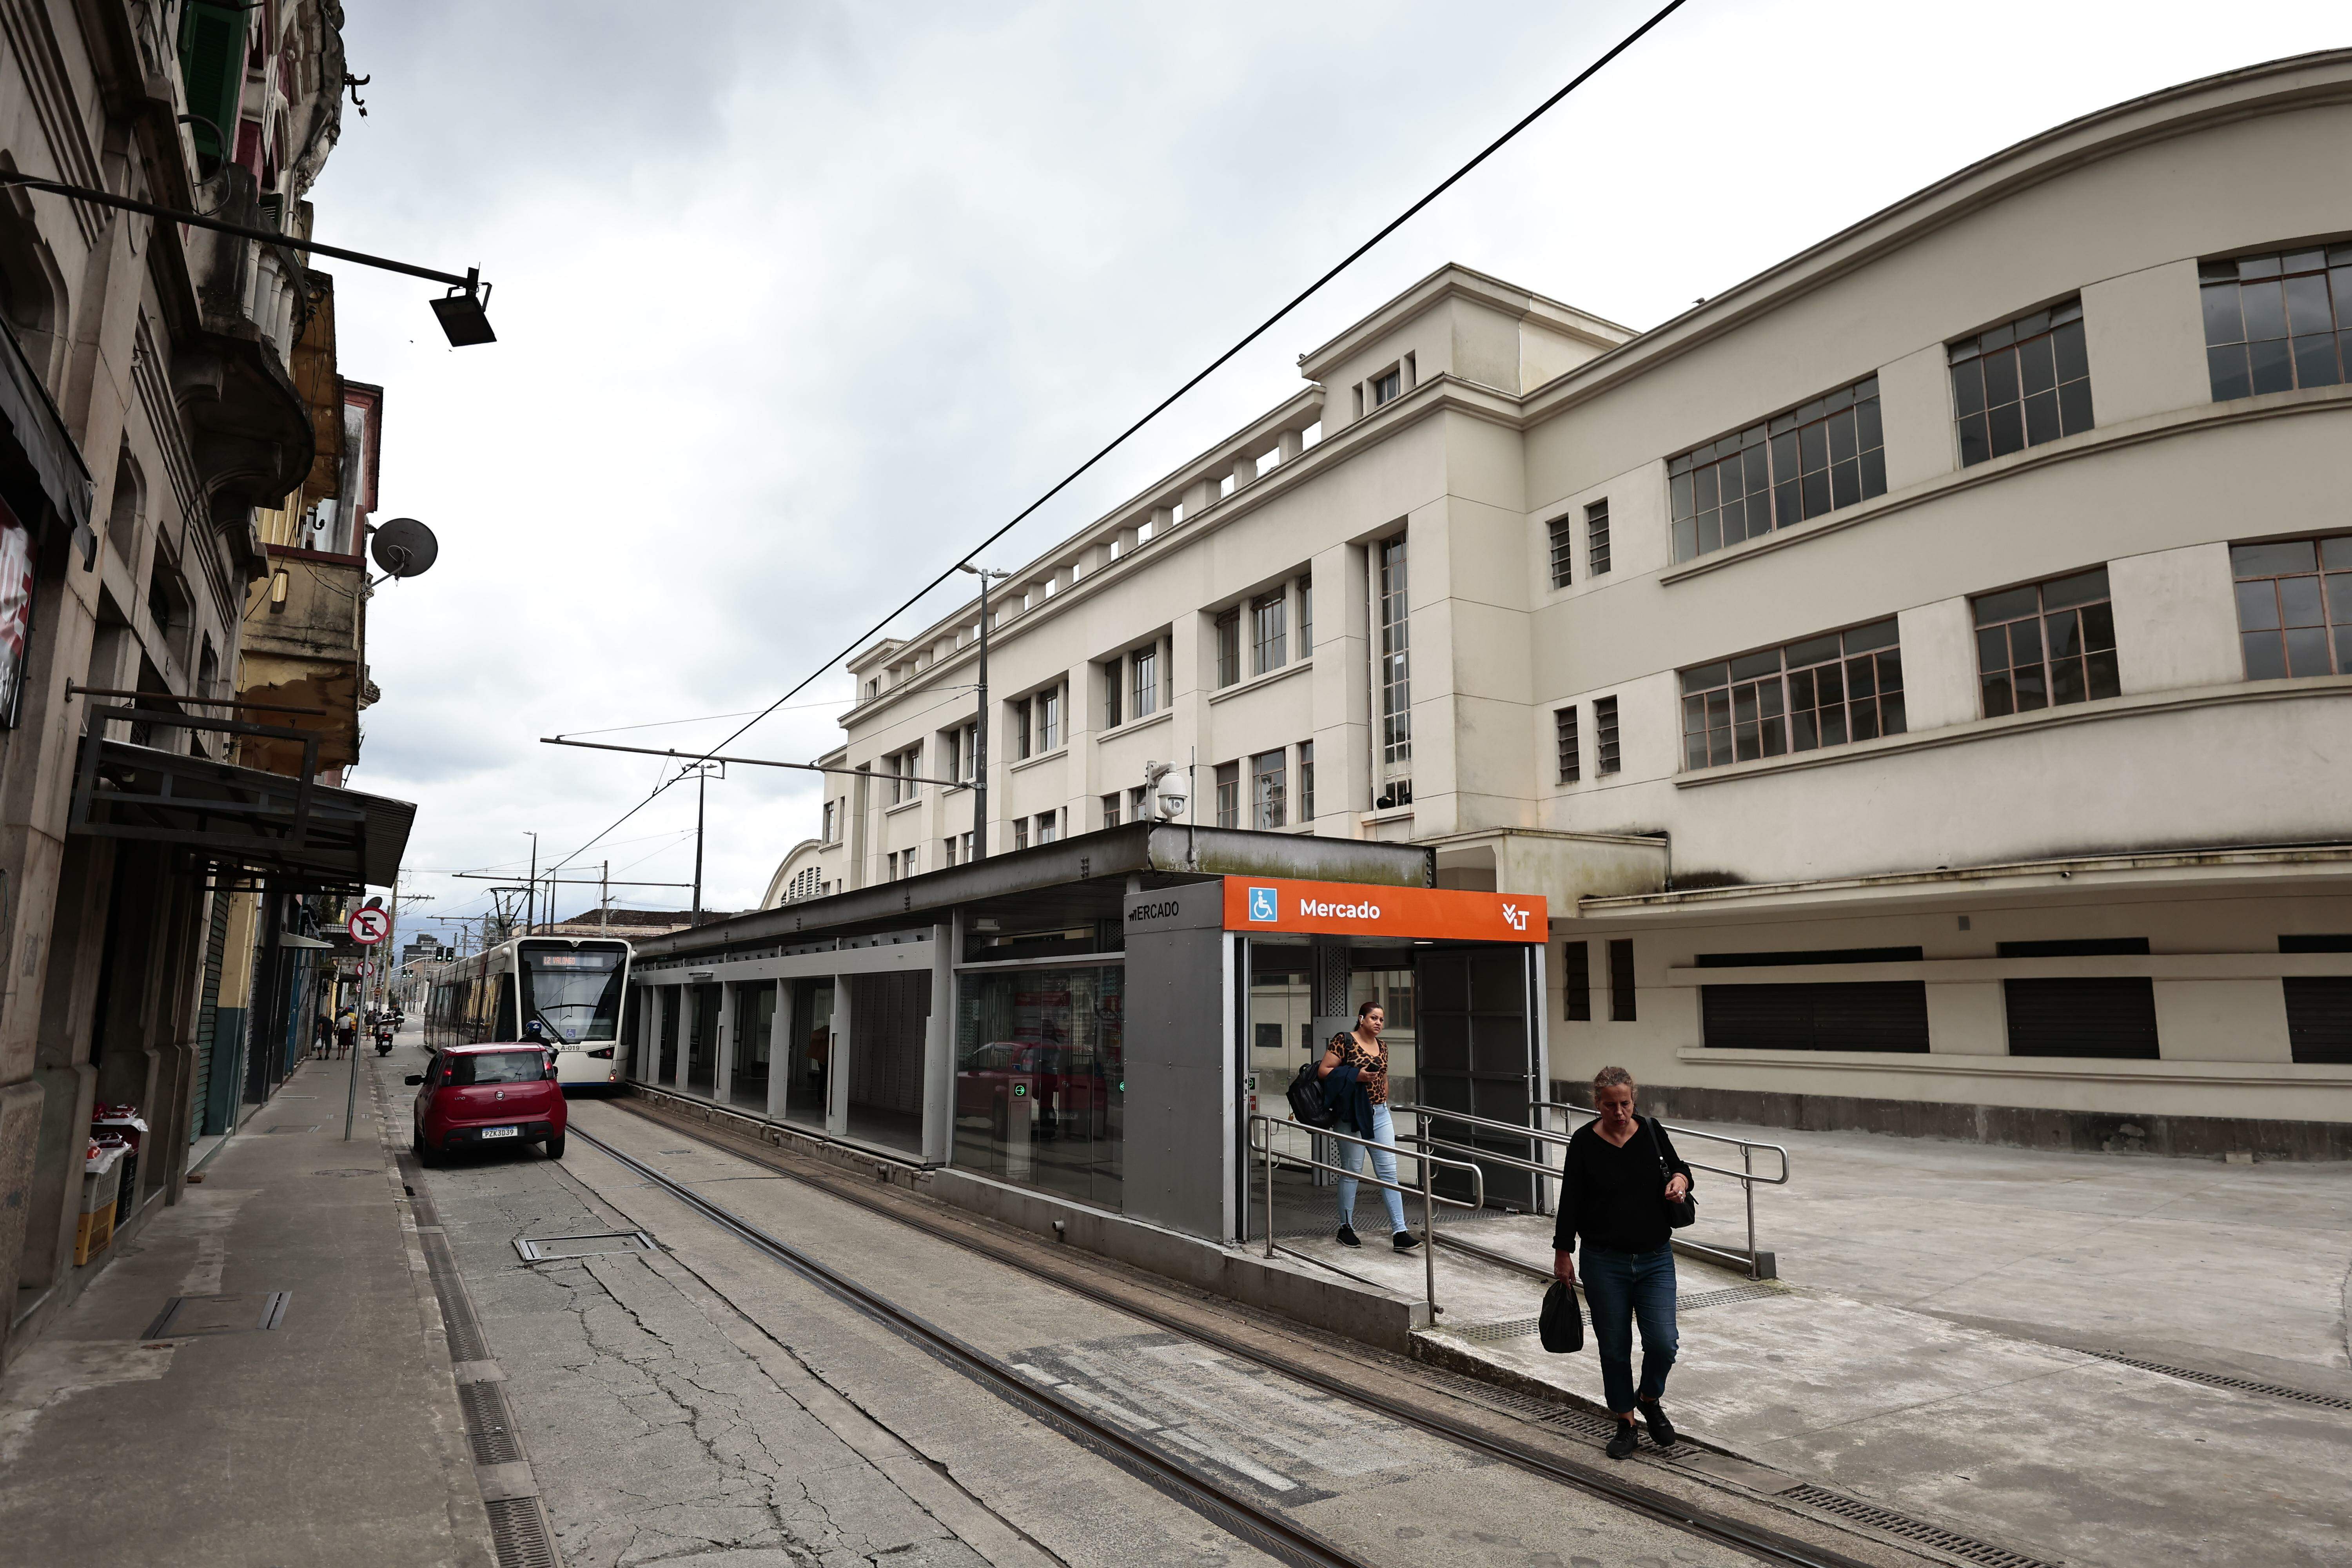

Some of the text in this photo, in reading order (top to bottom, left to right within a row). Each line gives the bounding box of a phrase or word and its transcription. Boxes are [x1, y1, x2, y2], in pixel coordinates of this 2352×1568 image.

[1128, 901, 1179, 922] MERCADO
[1301, 898, 1380, 919] Mercado
[361, 917, 376, 936] E
[485, 1129, 514, 1137] PZK3D39
